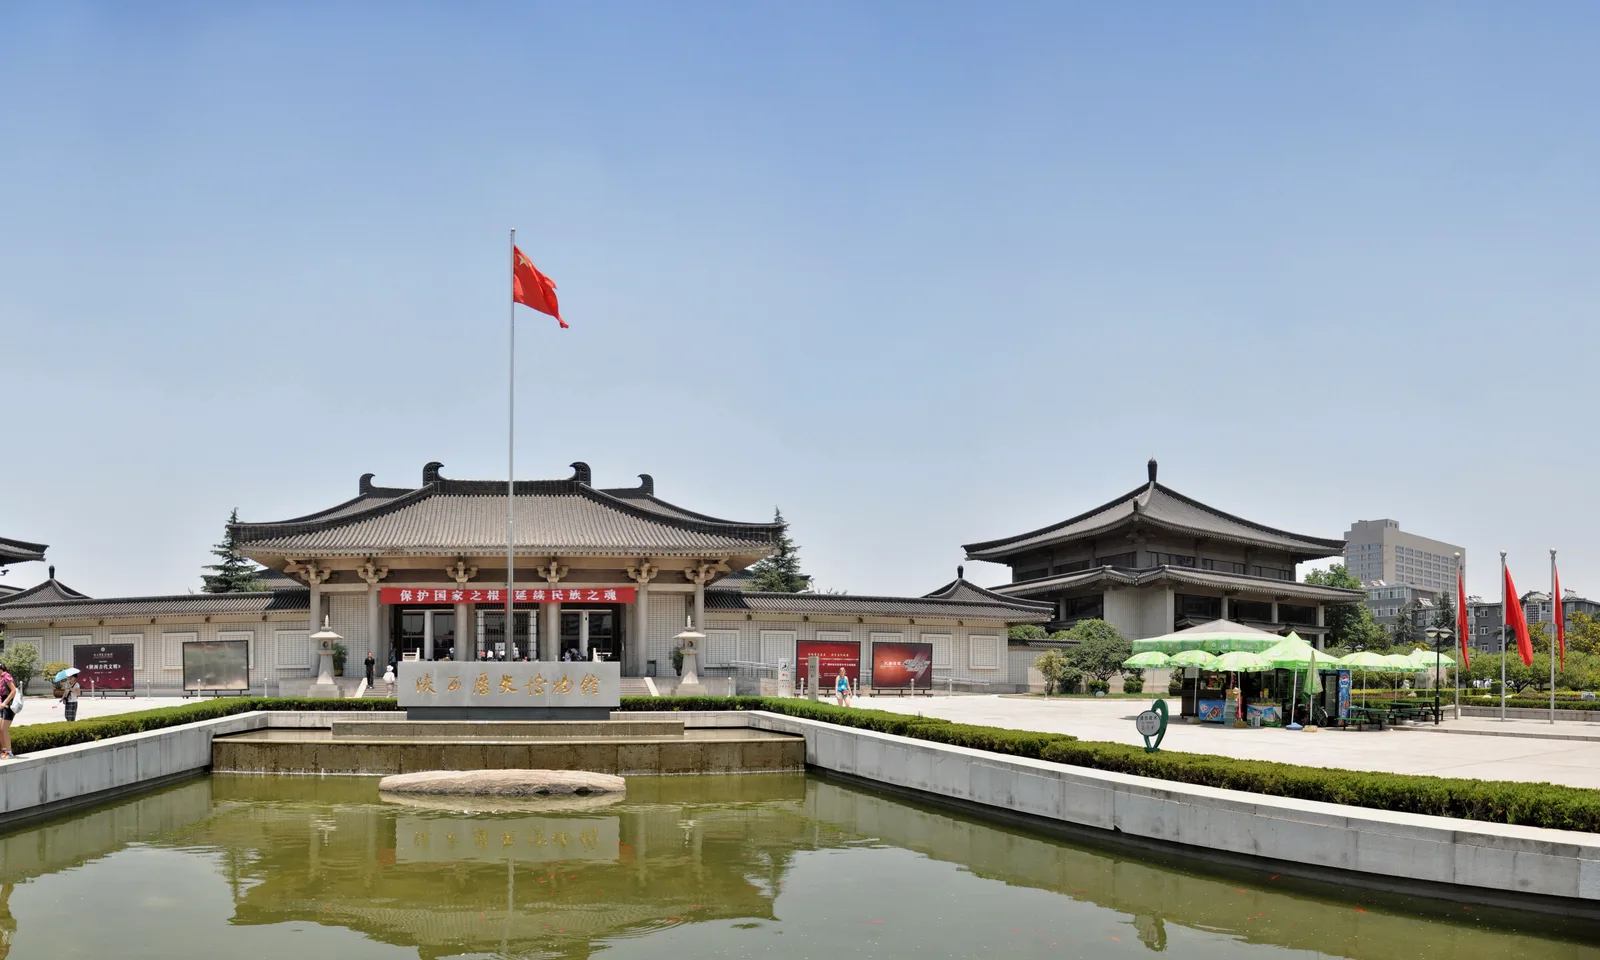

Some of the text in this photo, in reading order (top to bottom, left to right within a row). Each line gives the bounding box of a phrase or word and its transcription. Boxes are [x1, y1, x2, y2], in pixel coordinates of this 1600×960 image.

[400, 589, 617, 602] 保护国家之根 延续民族之魂
